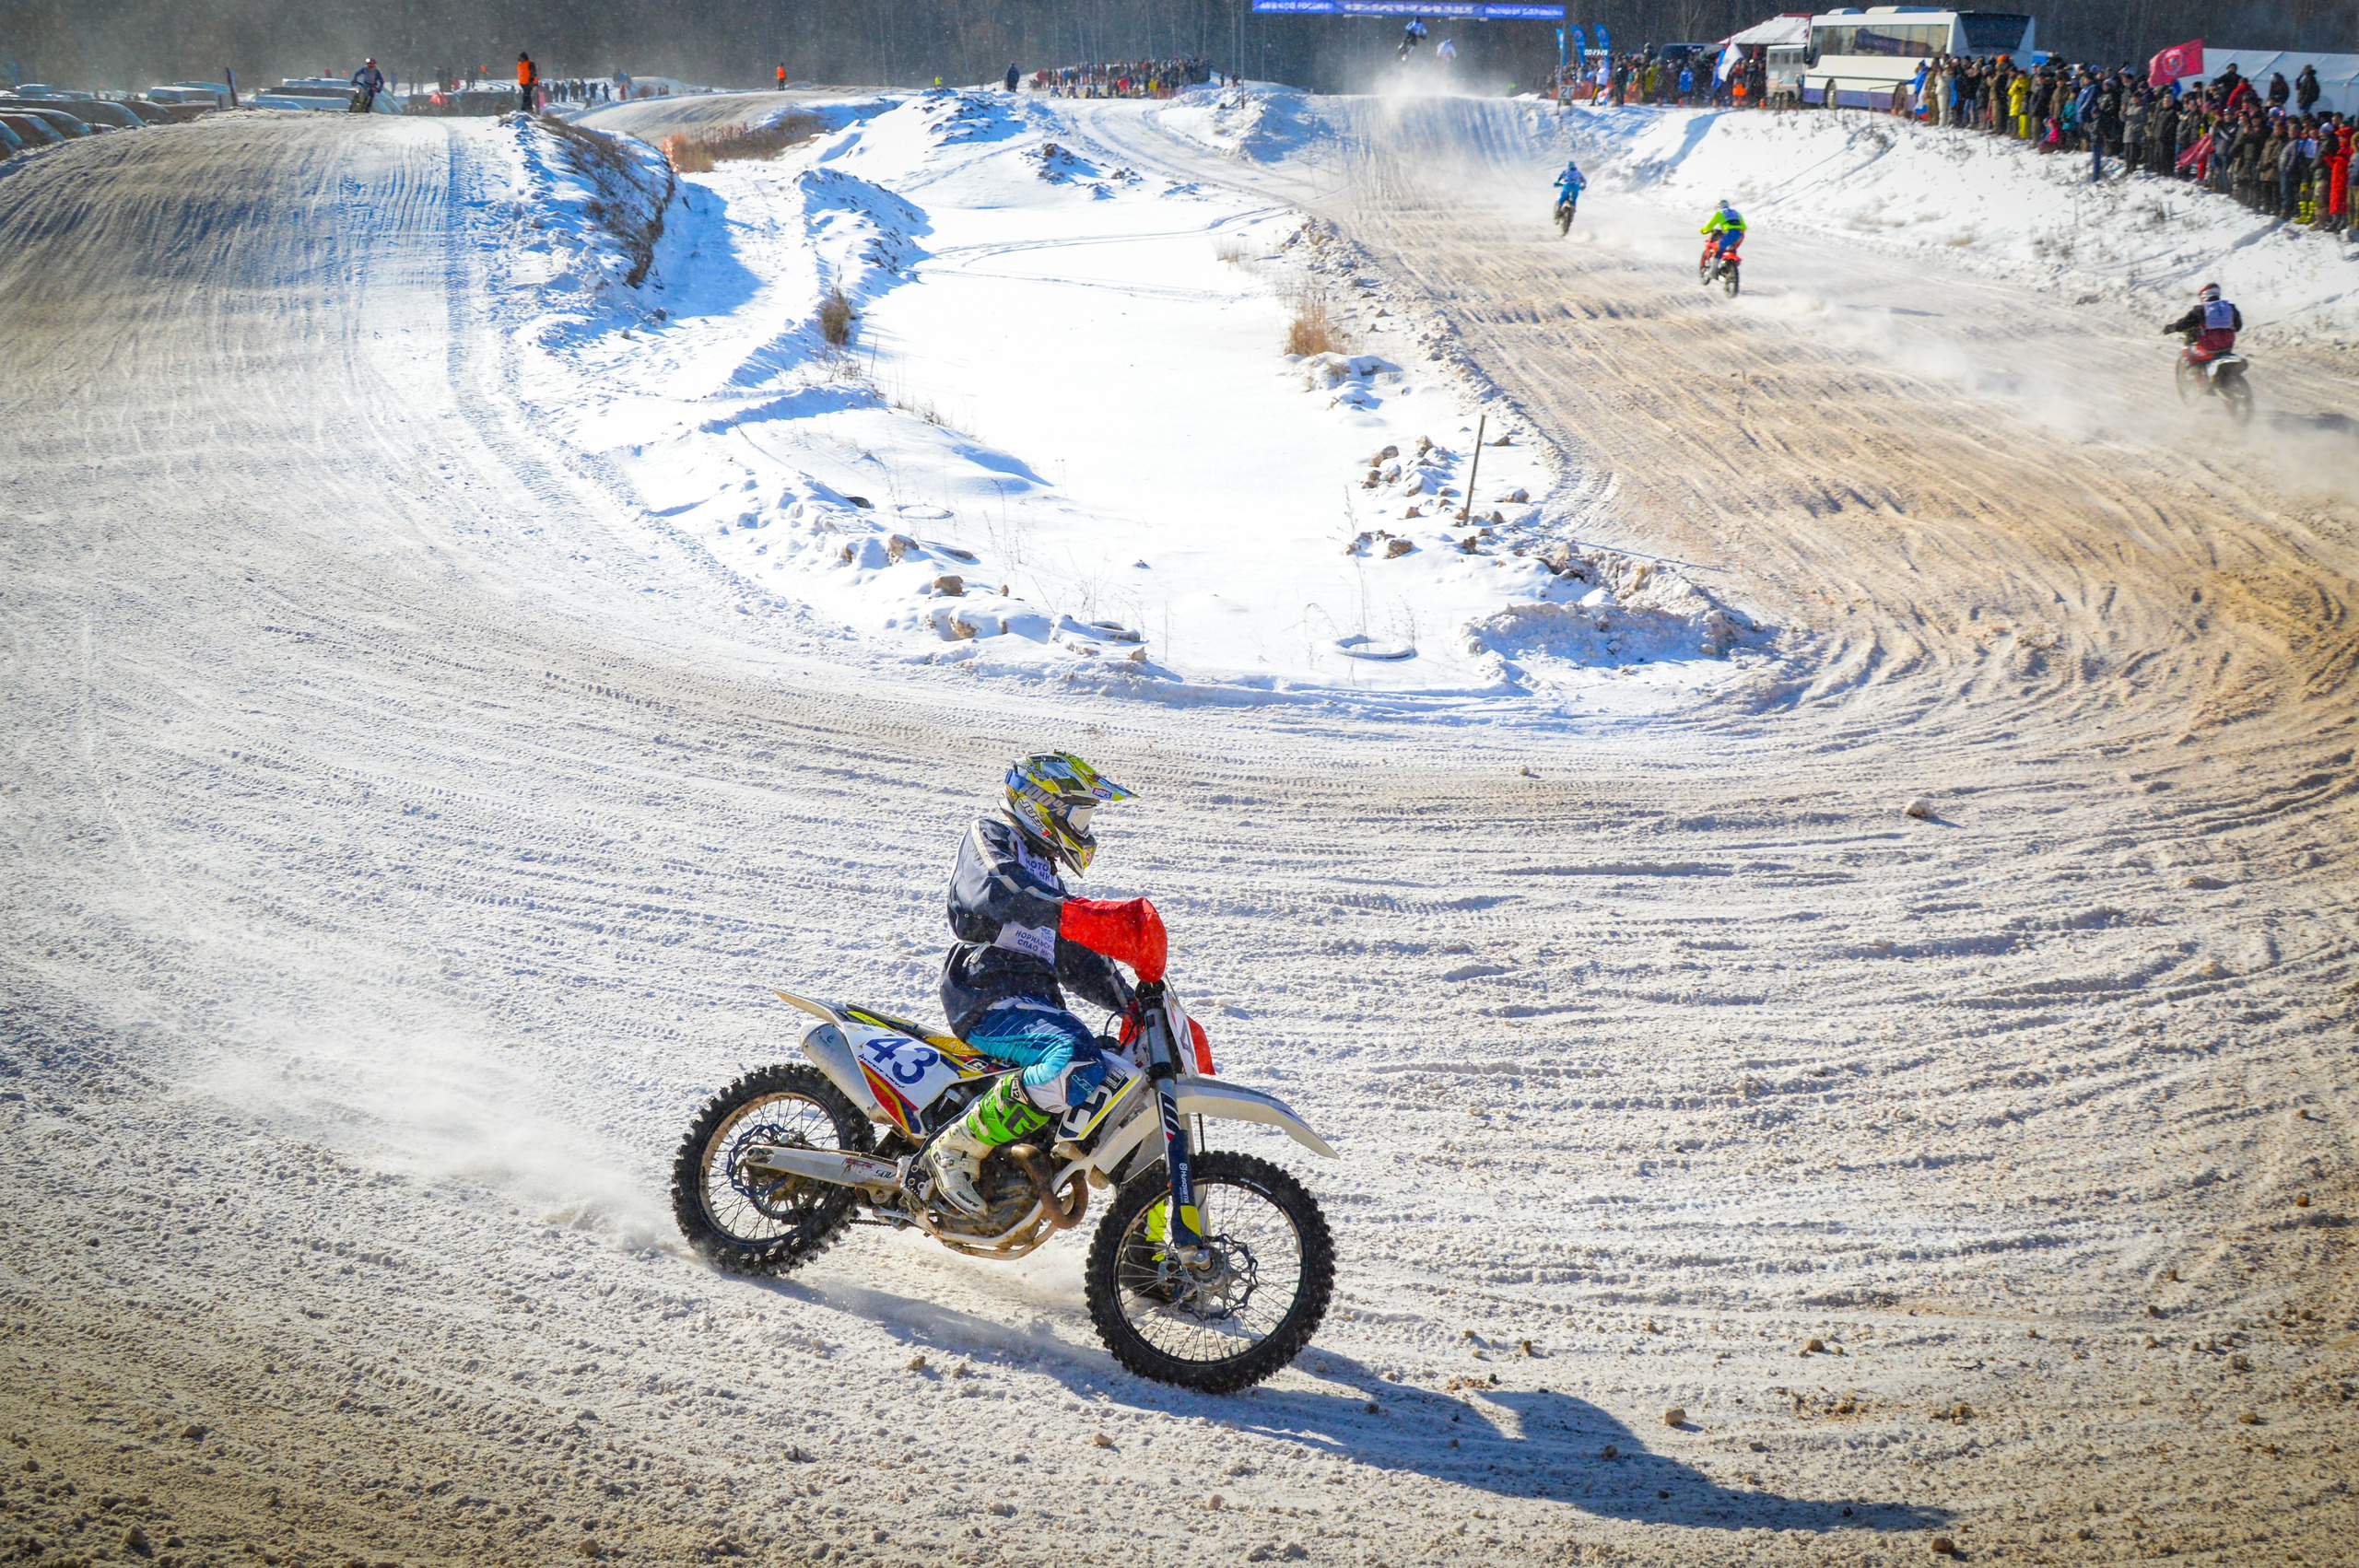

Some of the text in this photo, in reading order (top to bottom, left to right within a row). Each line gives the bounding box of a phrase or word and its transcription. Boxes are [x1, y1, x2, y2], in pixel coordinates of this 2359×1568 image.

[1020, 781, 1067, 817] 100%
[1017, 939, 1038, 951] СПАО
[865, 1037, 939, 1084] 43
[1181, 1170, 1190, 1204] Husqvarna
